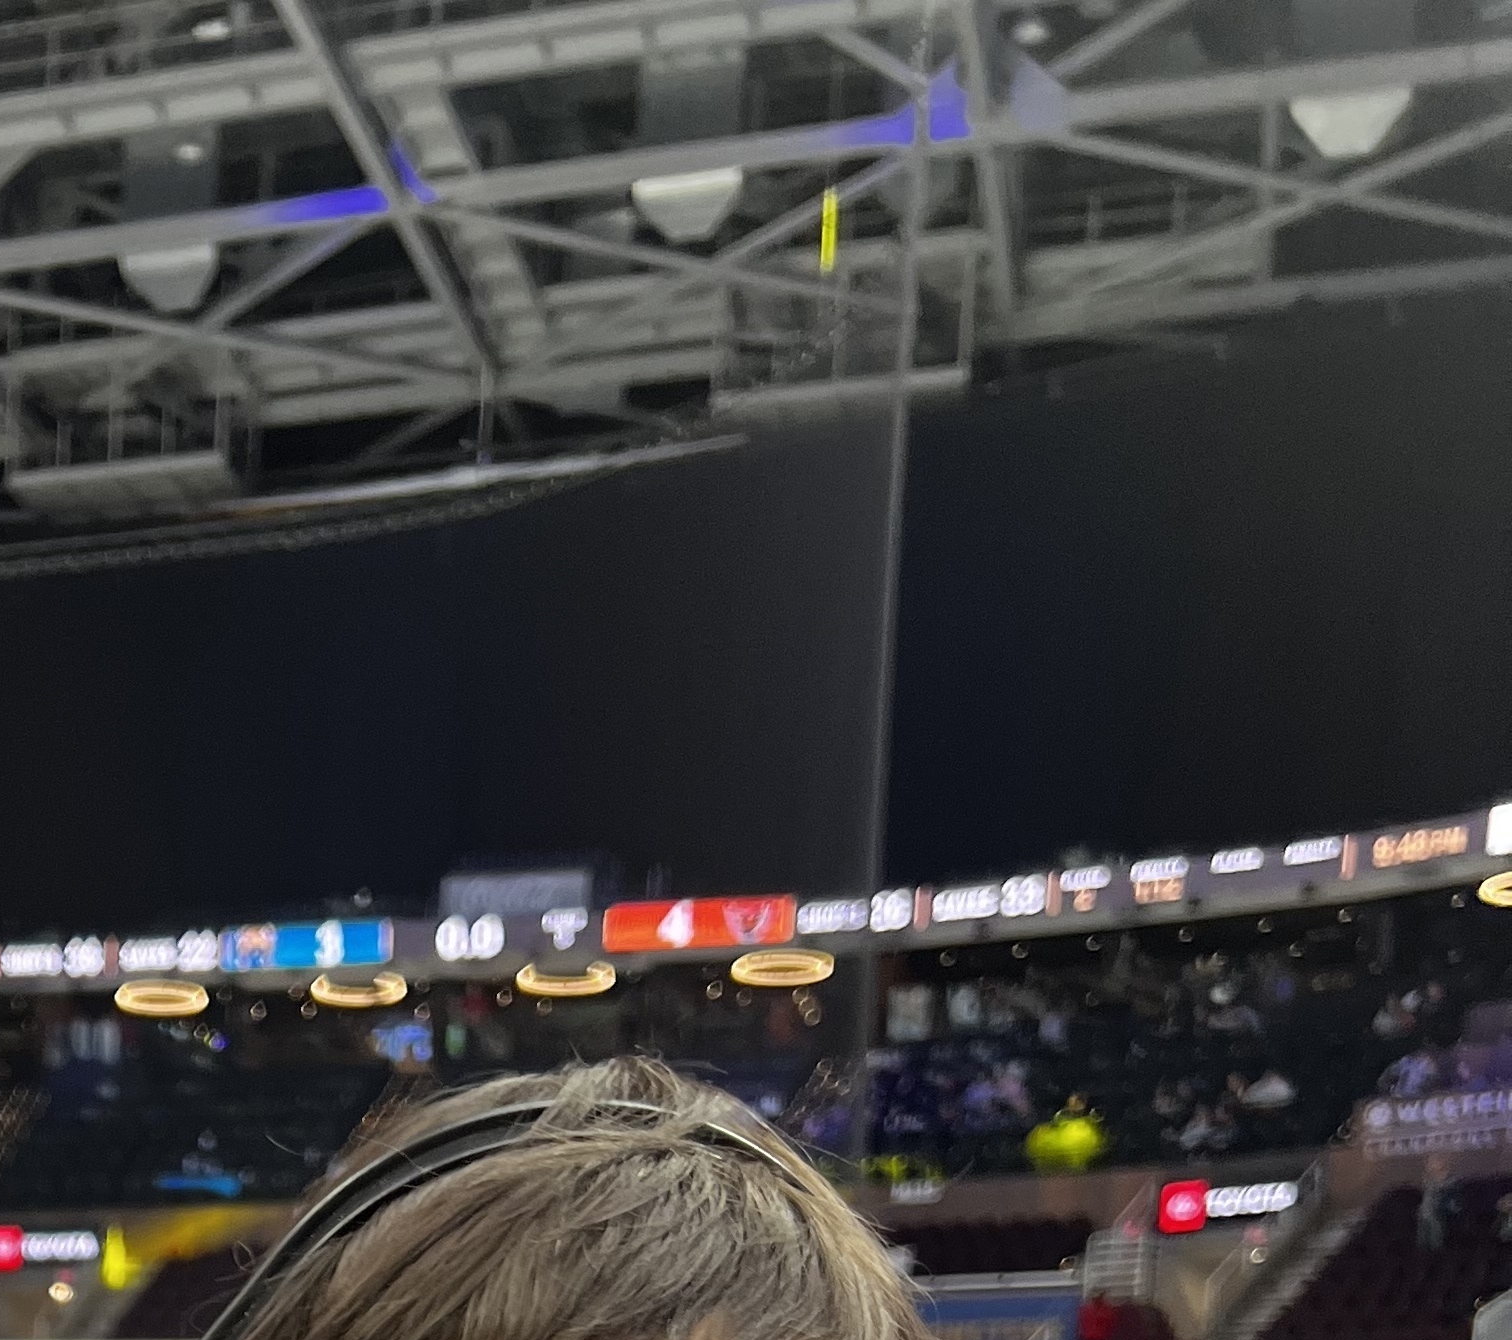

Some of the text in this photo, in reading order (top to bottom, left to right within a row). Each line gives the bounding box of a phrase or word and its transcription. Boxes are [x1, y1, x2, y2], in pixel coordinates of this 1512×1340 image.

[656, 898, 695, 948] 4
[119, 938, 178, 971] SAVES
[1205, 1182, 1298, 1217] TOYOTA
